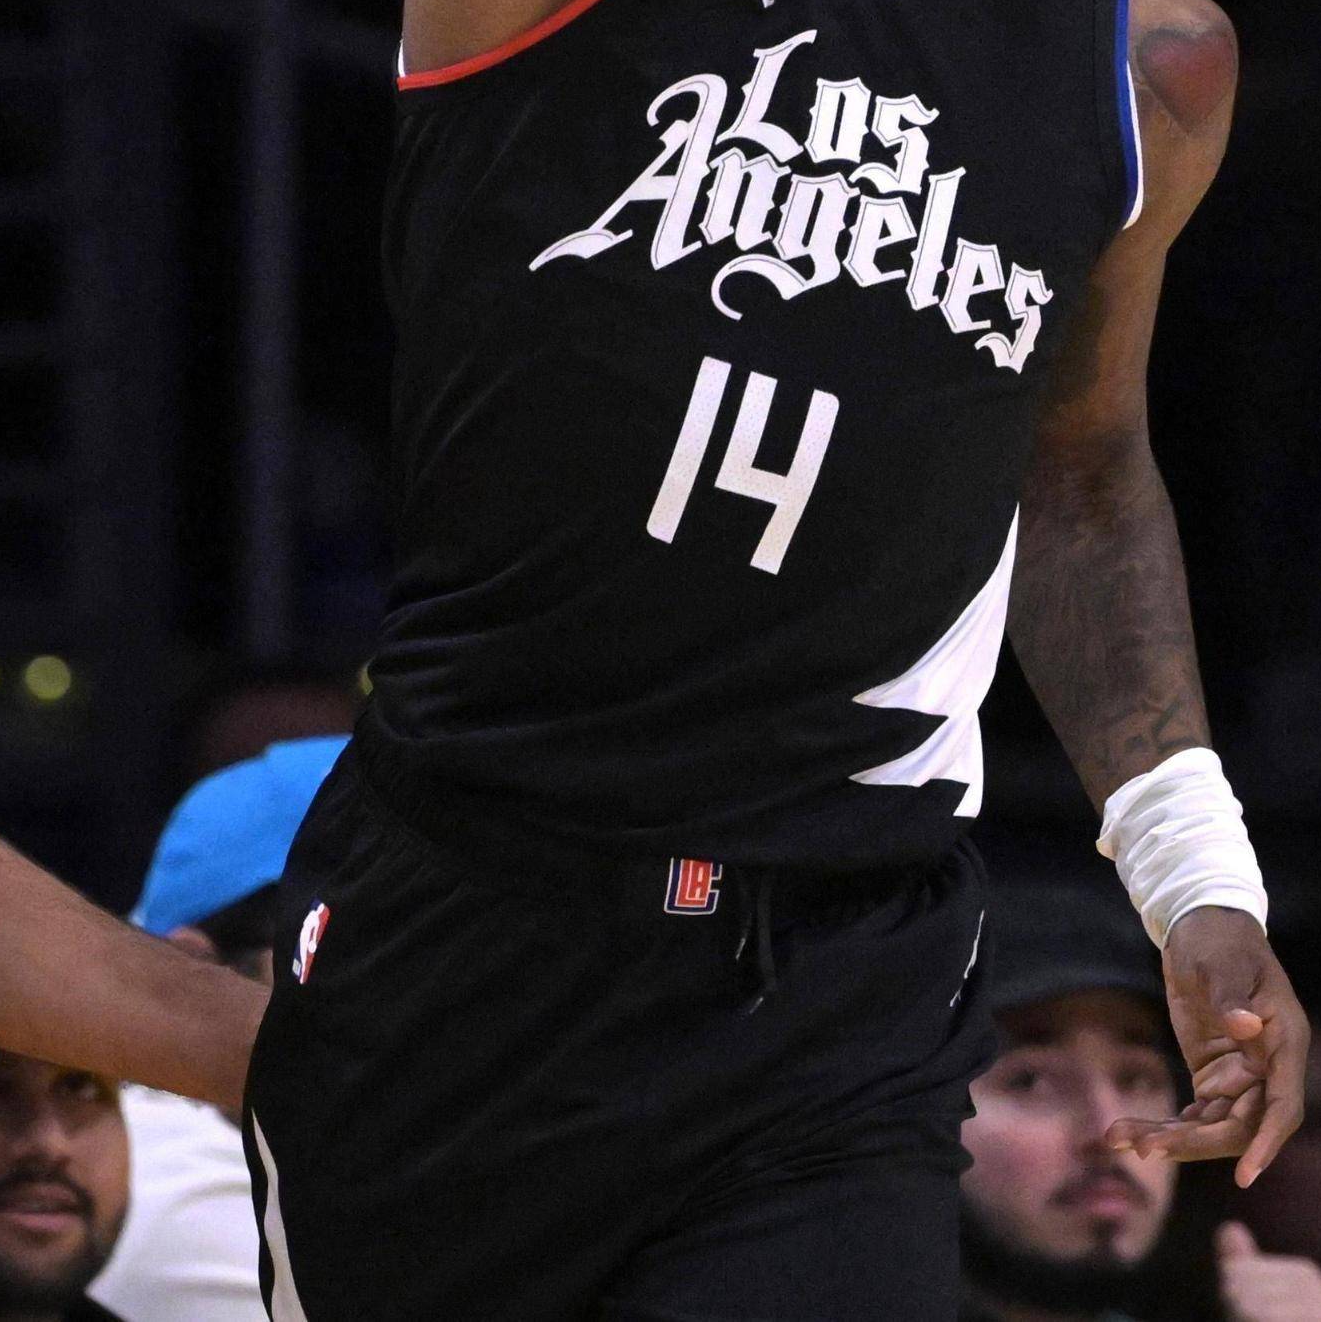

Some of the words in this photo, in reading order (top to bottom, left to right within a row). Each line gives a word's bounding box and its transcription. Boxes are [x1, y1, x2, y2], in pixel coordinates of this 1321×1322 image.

[714, 29, 940, 195] Los
[528, 73, 1054, 375] Angeles
[646, 356, 840, 575] 14
